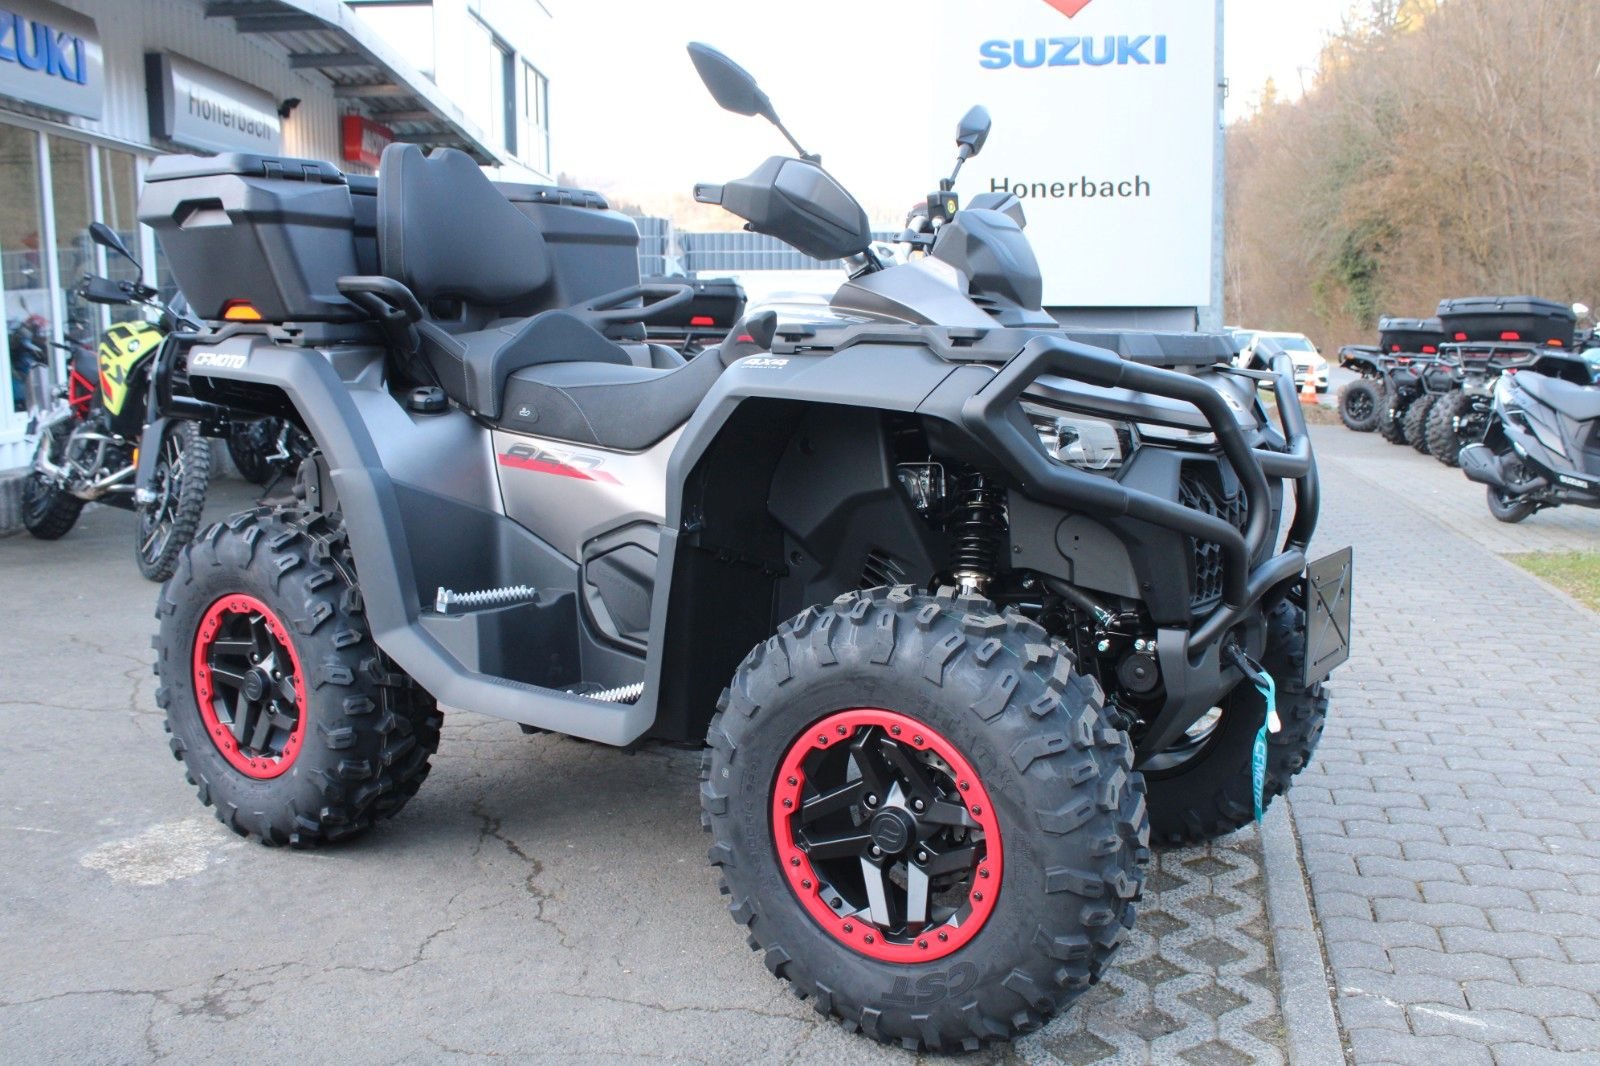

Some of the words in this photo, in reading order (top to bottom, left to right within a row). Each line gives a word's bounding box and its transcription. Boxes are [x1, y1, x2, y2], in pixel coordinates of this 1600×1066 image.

[978, 34, 1167, 70] SUZUKI
[990, 175, 1150, 198] Honerbach
[193, 352, 248, 369] CFMOTO
[1254, 741, 1266, 808] CFMOTO
[881, 961, 979, 1005] CST
